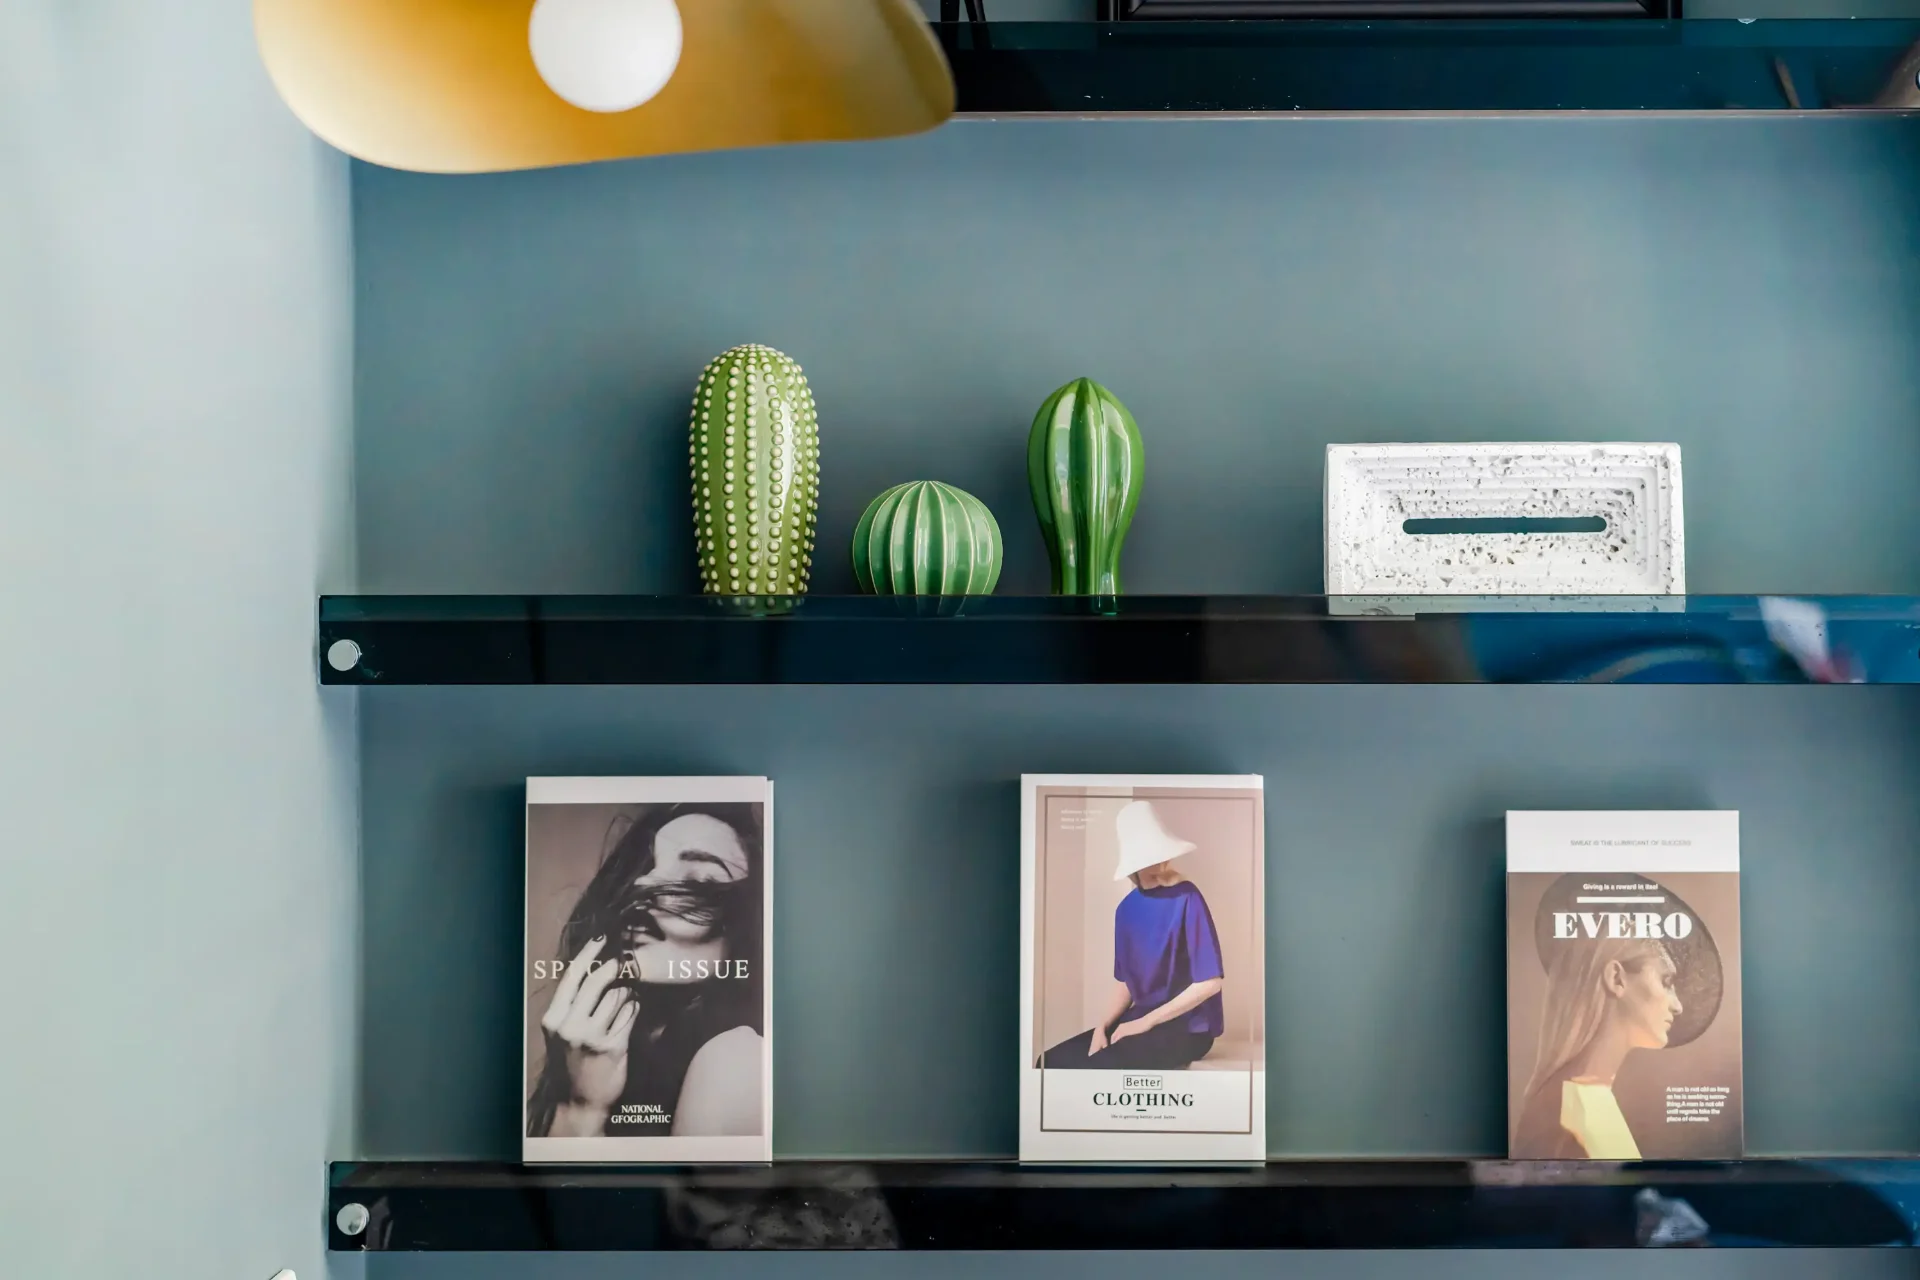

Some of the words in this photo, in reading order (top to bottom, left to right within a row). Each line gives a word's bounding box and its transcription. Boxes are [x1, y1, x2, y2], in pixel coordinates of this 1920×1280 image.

[1583, 883, 1603, 891] Giving
[1553, 912, 1692, 939] EVERO
[668, 960, 750, 979] ISSUE
[1126, 1077, 1161, 1087] Better
[1093, 1092, 1194, 1107] CLOTHING
[621, 1104, 664, 1113] NATIONAL
